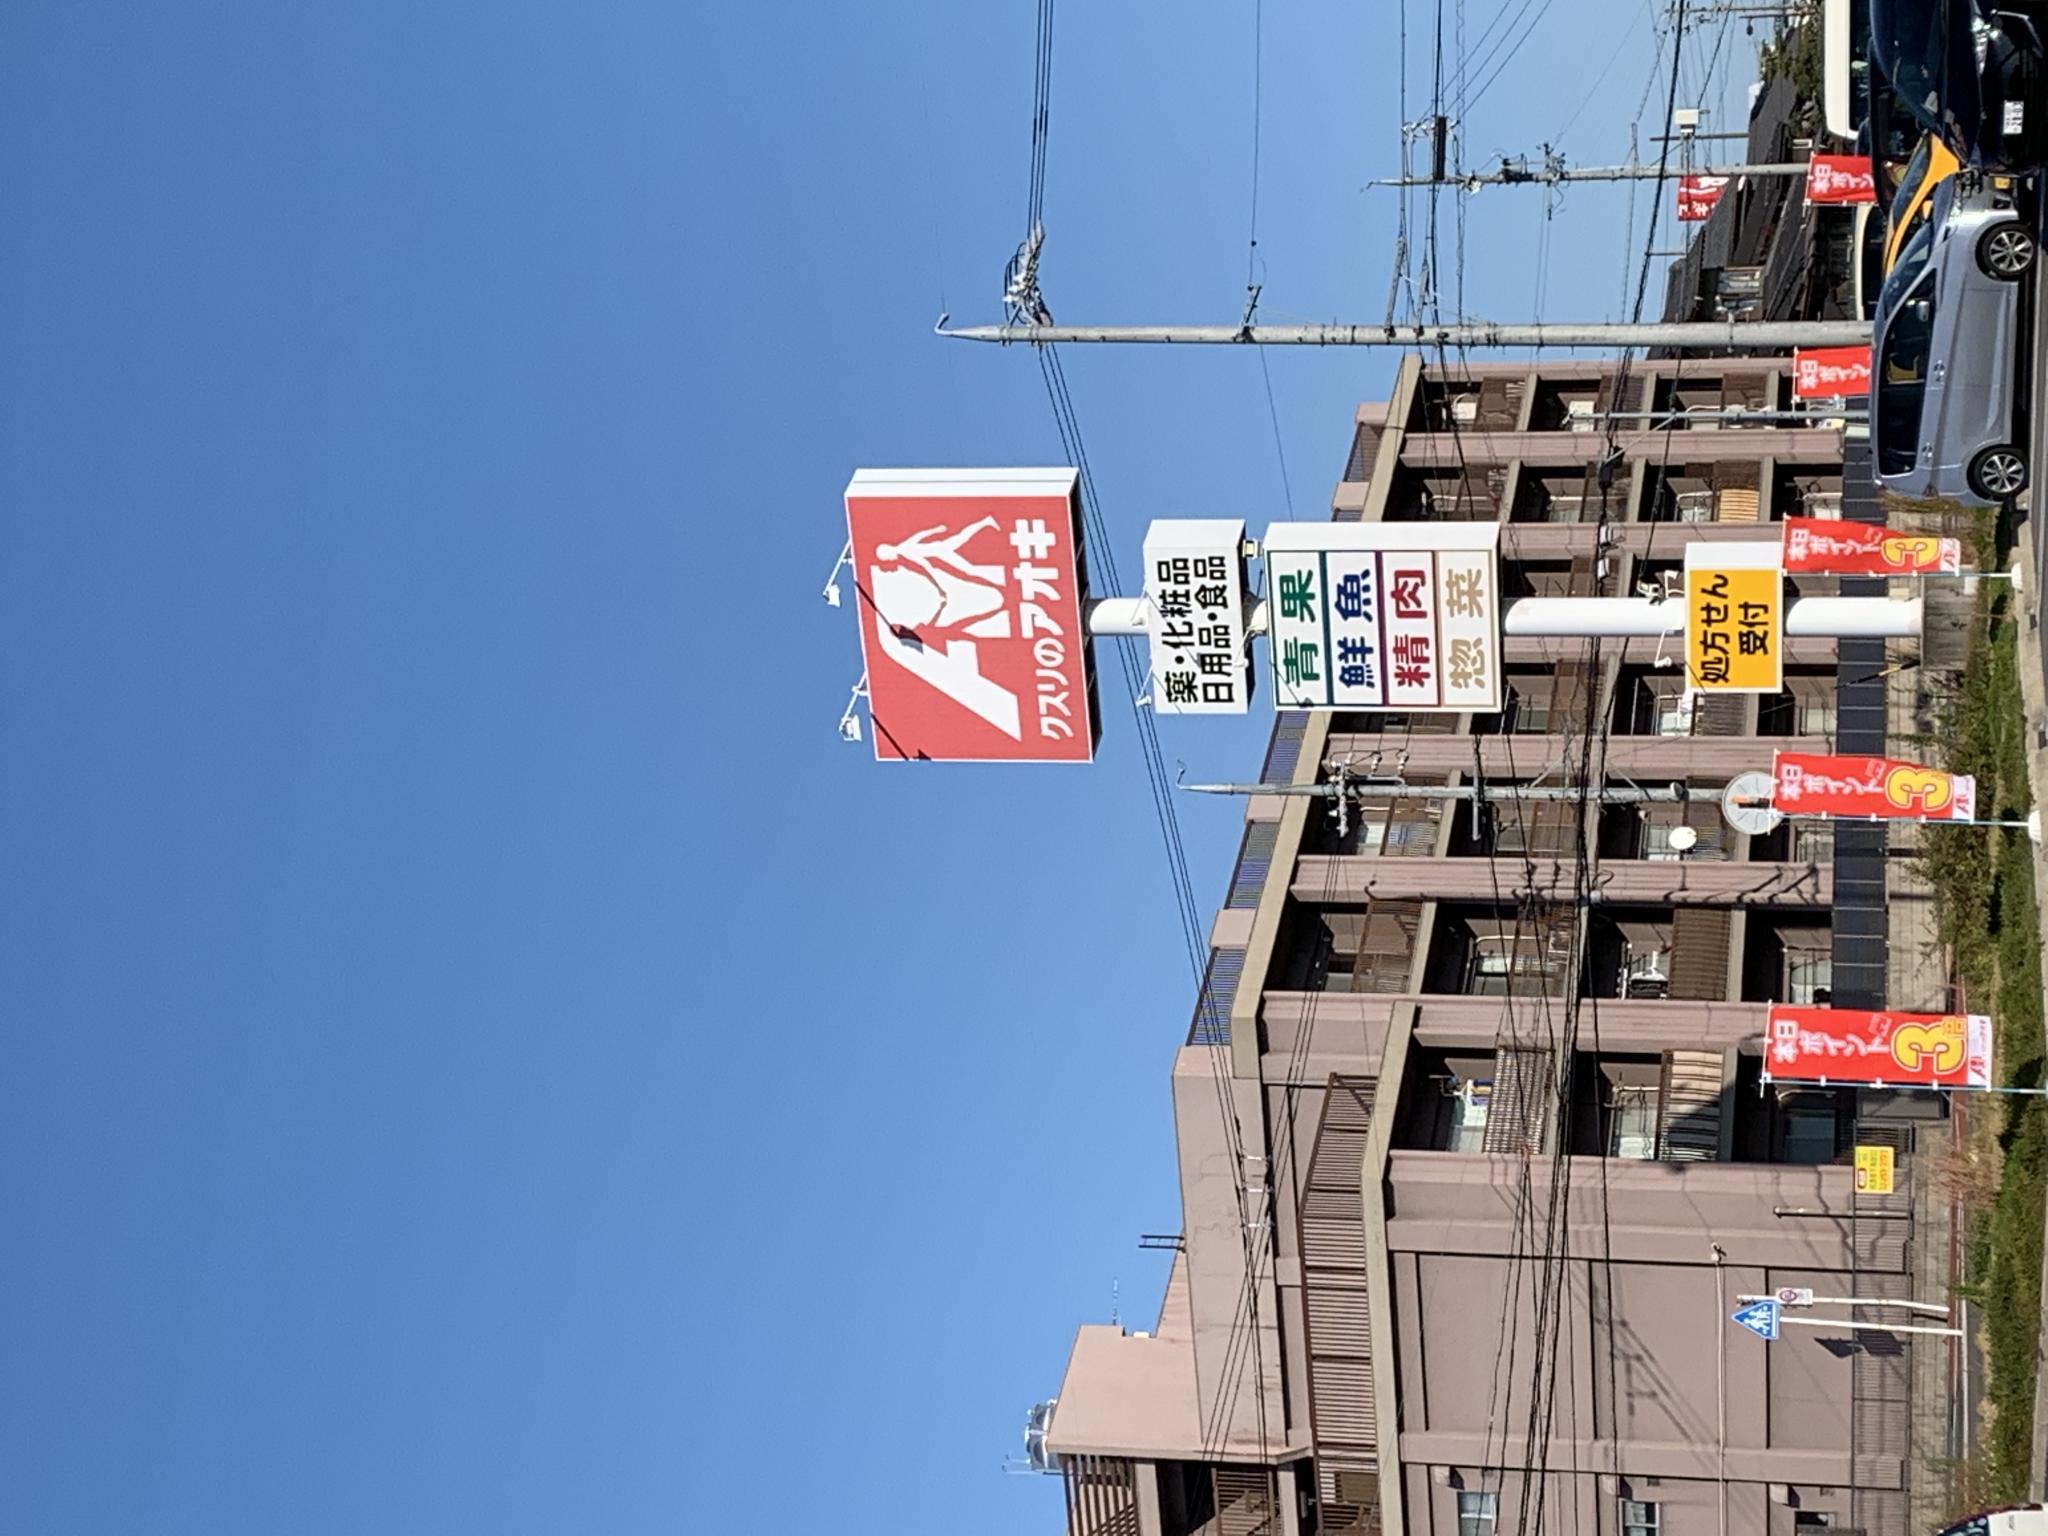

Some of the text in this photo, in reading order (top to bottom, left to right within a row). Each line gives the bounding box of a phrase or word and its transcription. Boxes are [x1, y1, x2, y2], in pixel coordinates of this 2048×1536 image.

[1811, 163, 1832, 194] 本日
[1799, 359, 1819, 390] 本日
[1818, 363, 1871, 384] ポイン
[1788, 528, 1810, 562] 本日
[1009, 518, 1074, 739] クスリのアオキ
[1157, 557, 1198, 704] 薬・化粧品
[1193, 555, 1235, 704] 日用品・食品
[1279, 569, 1320, 688] 青果
[1334, 568, 1375, 689] 鮮魚
[1390, 569, 1431, 688] 精肉
[1446, 568, 1486, 689] 惣菜
[1699, 574, 1730, 684] 処方せん
[1738, 601, 1769, 656] 受付
[1780, 762, 1803, 801] 本日
[1772, 1019, 1800, 1063] 本日
